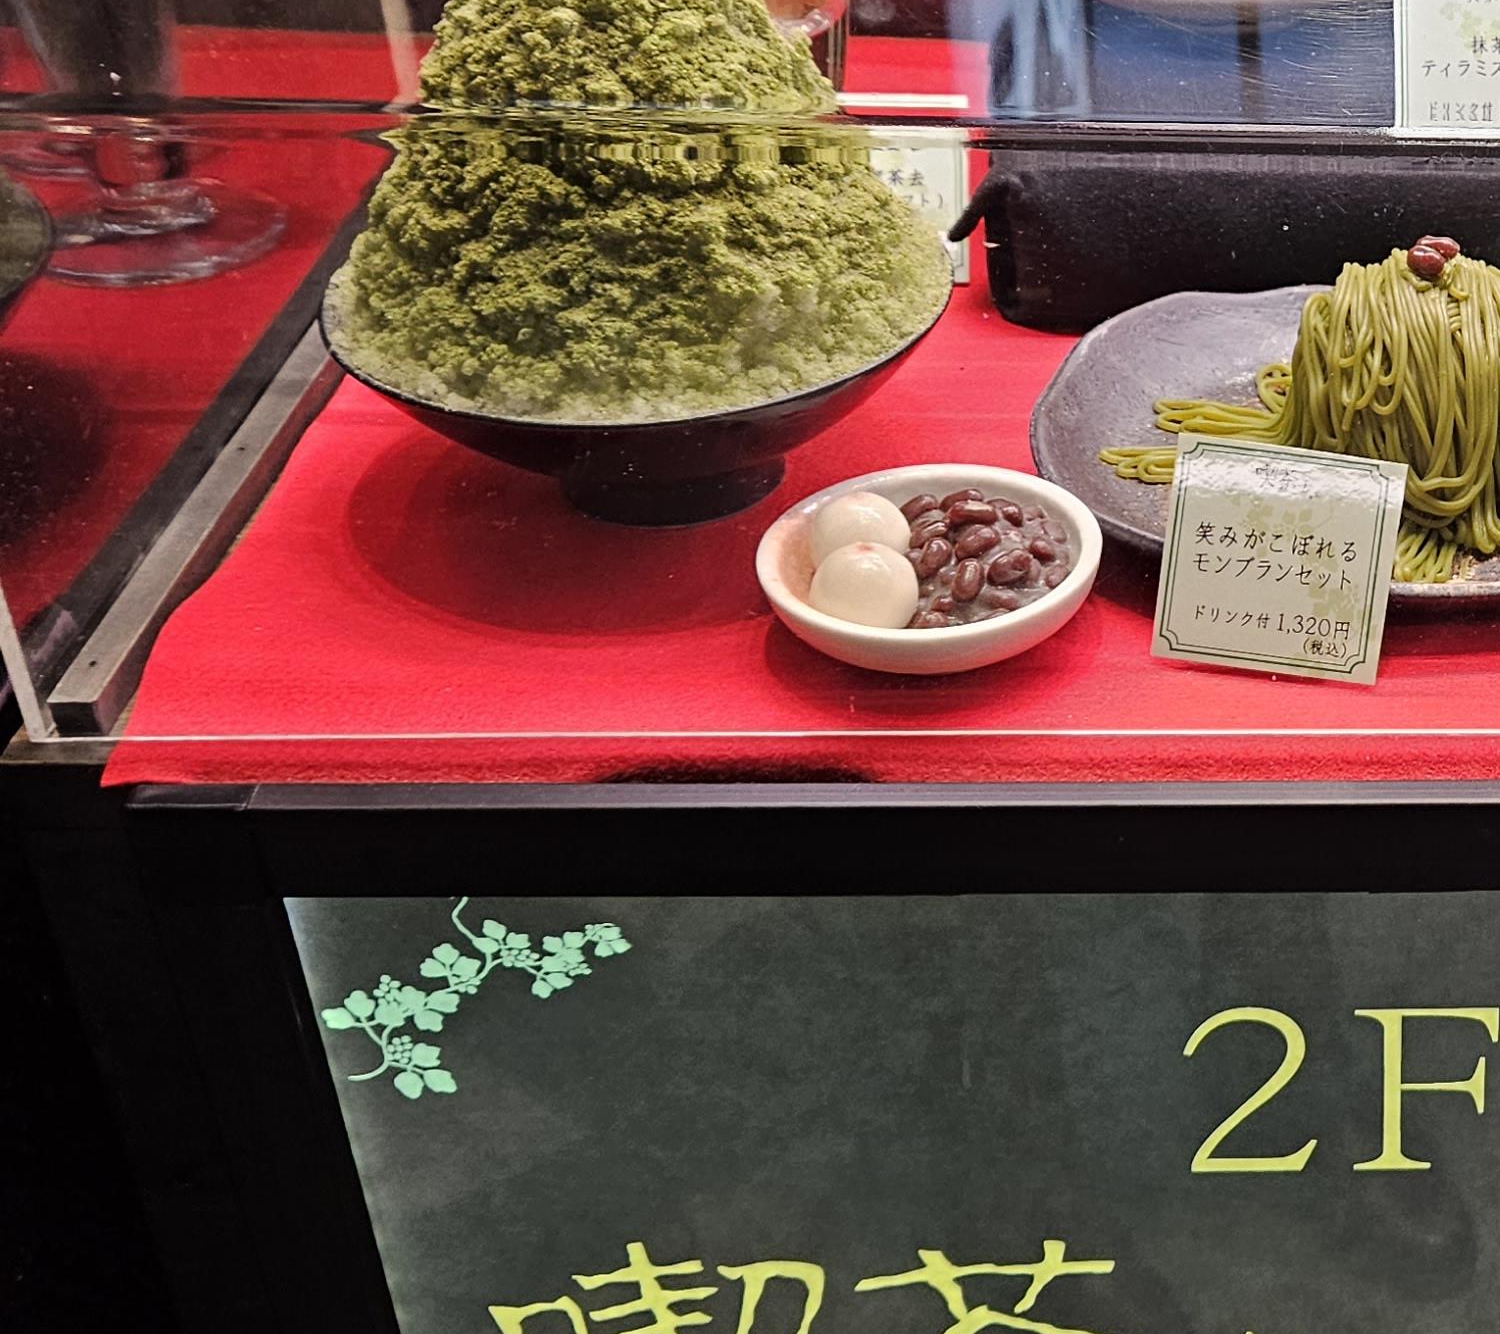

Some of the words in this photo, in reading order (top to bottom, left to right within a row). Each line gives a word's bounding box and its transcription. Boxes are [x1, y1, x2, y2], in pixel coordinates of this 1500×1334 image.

[1194, 520, 1358, 563] 笑みがこぼれる
[1192, 552, 1352, 591] モンブランセット
[1195, 604, 1271, 629] ドリンク付
[1276, 613, 1350, 640] 1,320円
[1182, 1005, 1500, 1174] 2F
